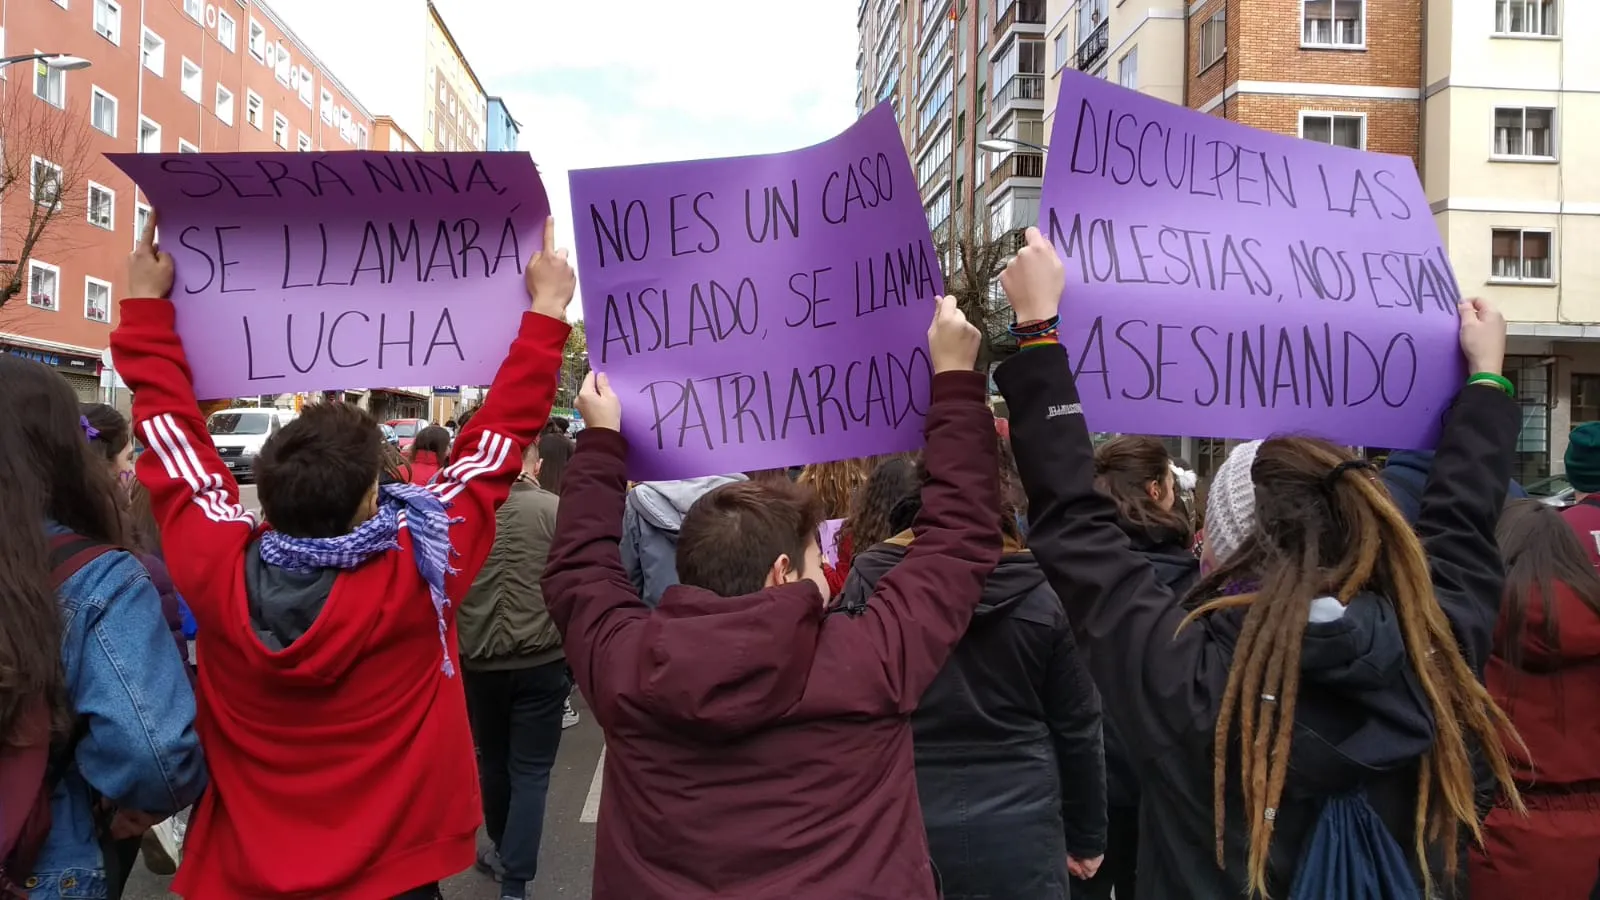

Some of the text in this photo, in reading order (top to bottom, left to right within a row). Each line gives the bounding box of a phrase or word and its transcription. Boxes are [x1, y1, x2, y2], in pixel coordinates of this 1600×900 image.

[160, 155, 355, 198] SERÁ
[590, 152, 893, 268] NO ES UN CASO
[1070, 97, 1412, 220] DISCULPEN LAS
[179, 202, 523, 295] SE LLAMARÁ
[601, 238, 937, 364] AISLADO, SE LLAMA
[1048, 206, 1462, 316] MOLESTIAS, NOS ESTÁN
[242, 307, 465, 381] LUCHA
[1072, 315, 1418, 409] ASESINANDO
[639, 346, 934, 451] PATRIARCADO
